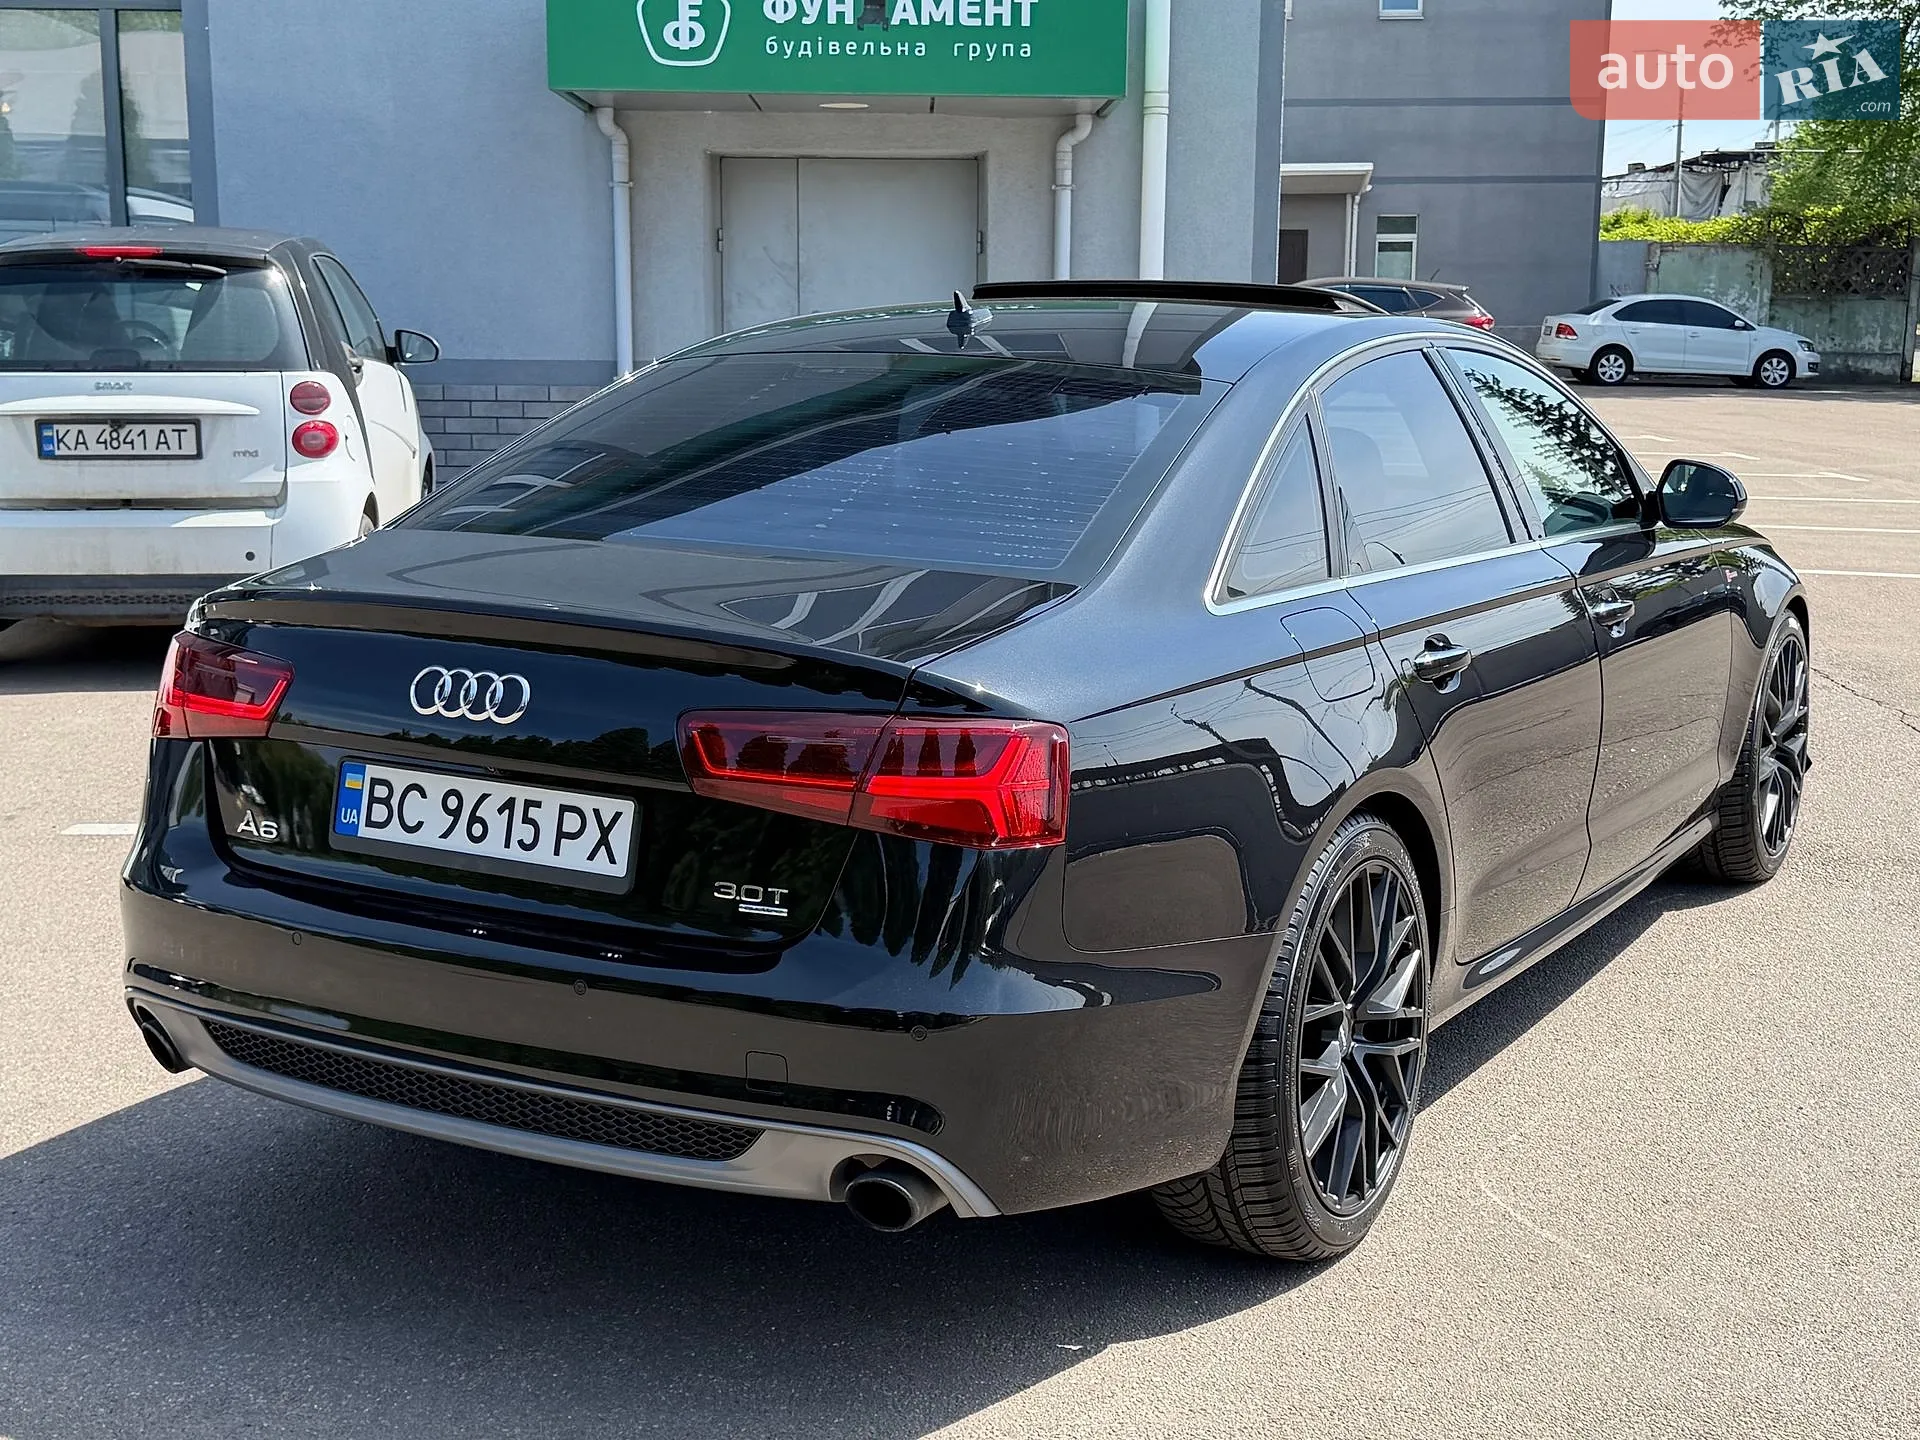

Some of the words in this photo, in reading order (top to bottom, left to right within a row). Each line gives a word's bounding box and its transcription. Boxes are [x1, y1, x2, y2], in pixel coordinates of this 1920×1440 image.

[763, 0, 1039, 26] ФУНАМЕНТ
[765, 36, 926, 59] будівельна
[953, 42, 1032, 62] група
[55, 428, 89, 451] KA
[95, 428, 147, 451] 4841
[155, 428, 188, 451] AT
[236, 809, 279, 839] A6
[341, 807, 358, 825] UA
[364, 776, 428, 835] BC
[438, 788, 543, 852] 9615
[553, 803, 623, 865] PX
